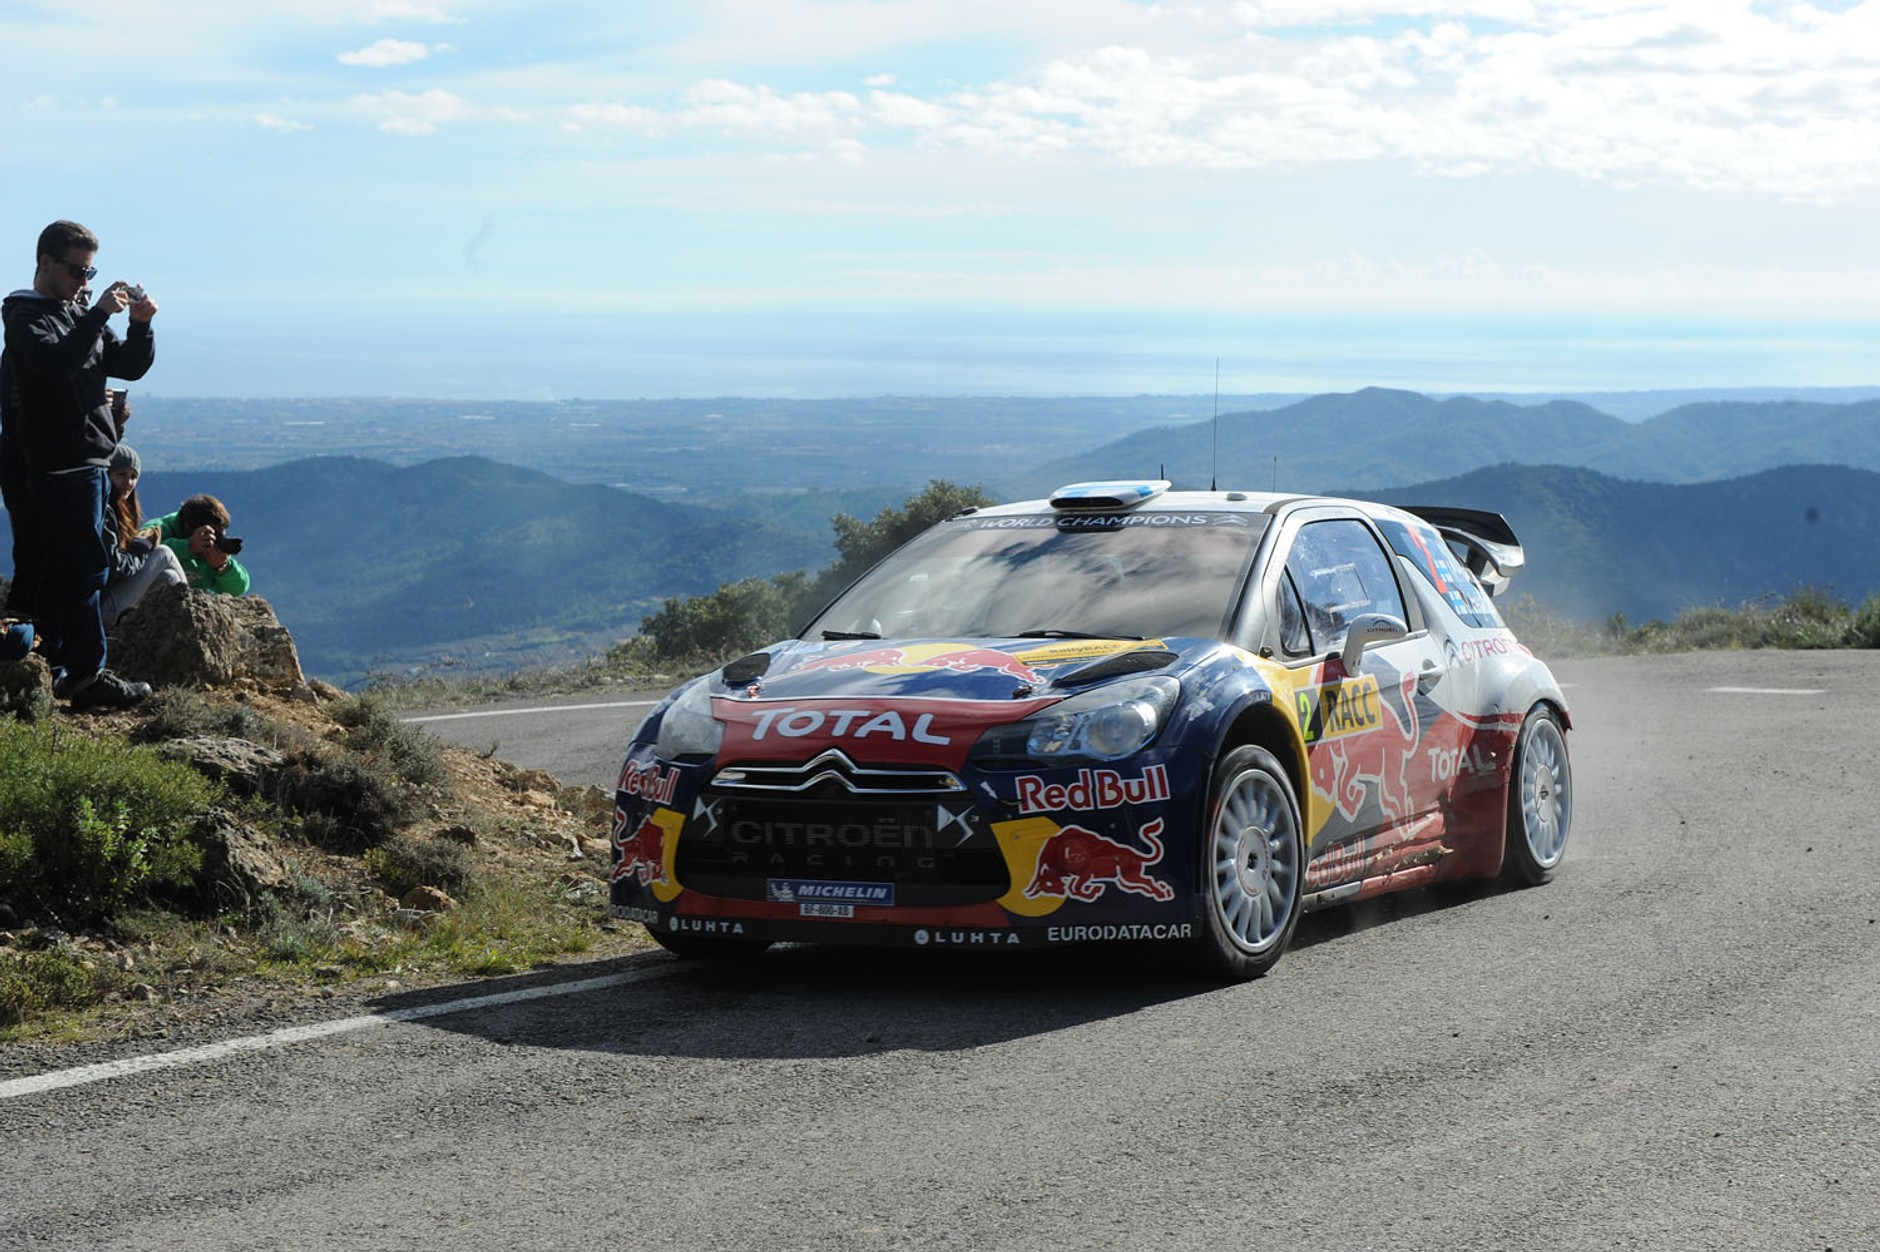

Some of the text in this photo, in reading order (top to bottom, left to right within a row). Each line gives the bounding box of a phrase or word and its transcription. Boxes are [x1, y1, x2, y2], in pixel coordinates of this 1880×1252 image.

[980, 515, 1207, 528] WORLD CHAMPIONS
[1461, 638, 1532, 662] CITRO
[1299, 690, 1315, 741] 2
[1325, 682, 1376, 733] RACC
[751, 707, 951, 746] TOTAL
[1428, 744, 1497, 784] TOTAL
[1015, 764, 1171, 814] Red Bull
[797, 885, 888, 898] MICHELIN
[681, 919, 743, 934] LUHTA
[935, 931, 1020, 944] LUHTA
[1047, 923, 1192, 942] EURODATACAR
